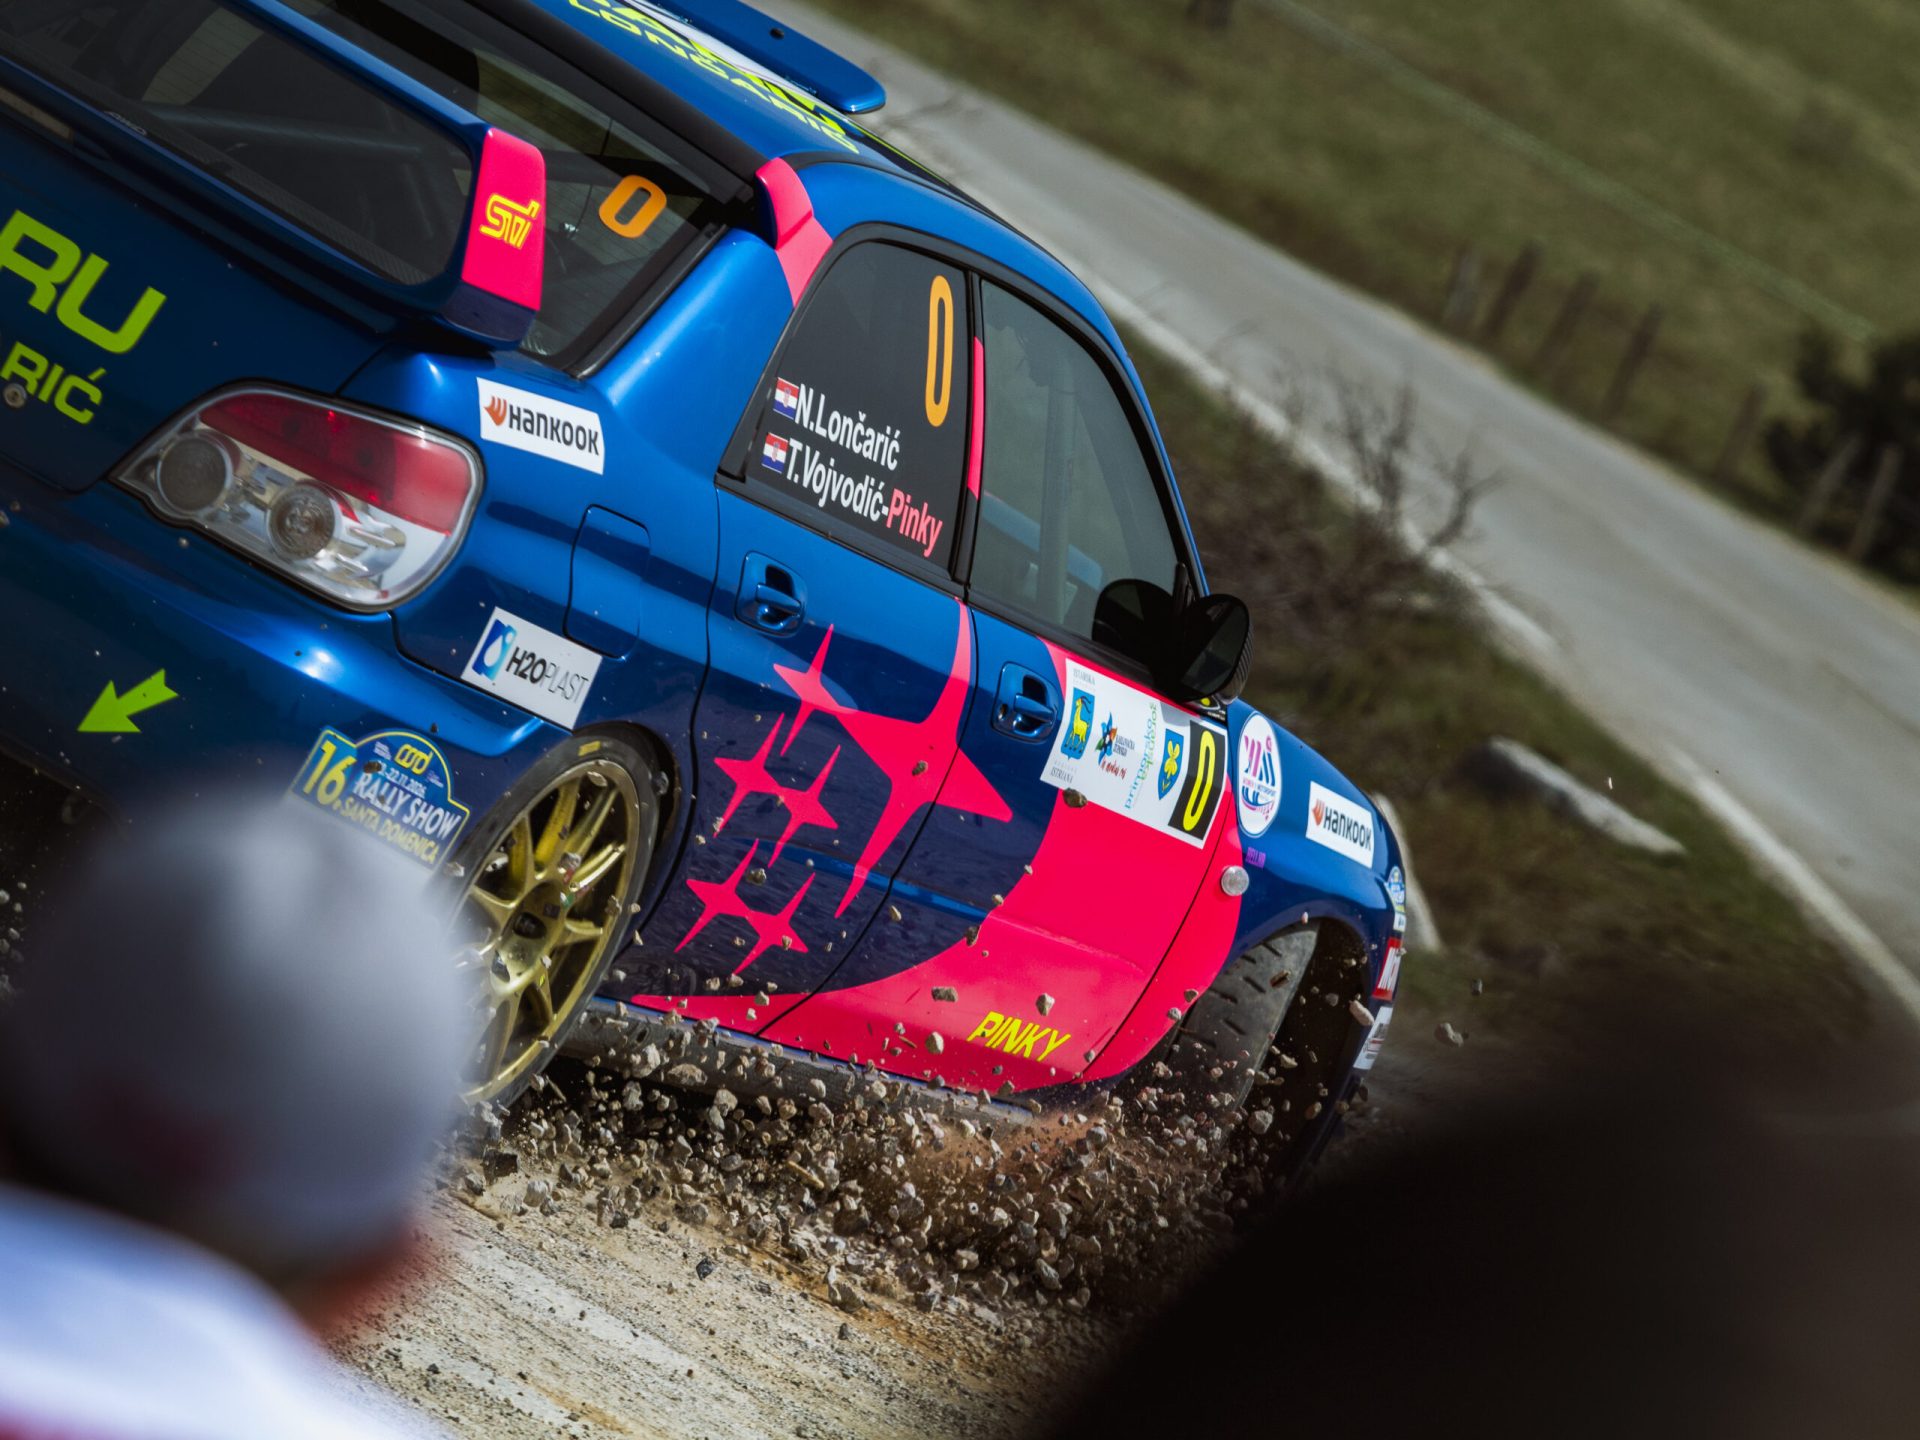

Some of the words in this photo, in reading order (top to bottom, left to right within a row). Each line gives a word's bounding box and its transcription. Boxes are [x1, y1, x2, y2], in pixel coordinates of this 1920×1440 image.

[598, 174, 667, 239] 0
[0, 209, 167, 354] RU
[0, 341, 107, 424] RIĆ
[925, 275, 954, 427] 0
[794, 383, 901, 471] N.Lončarić
[352, 772, 412, 817] RALLY
[402, 797, 462, 841] SHOW
[1183, 730, 1216, 832] 0
[340, 797, 381, 833] SANTA
[378, 818, 441, 865] DOMENICA
[966, 1010, 1072, 1062] PINKY
